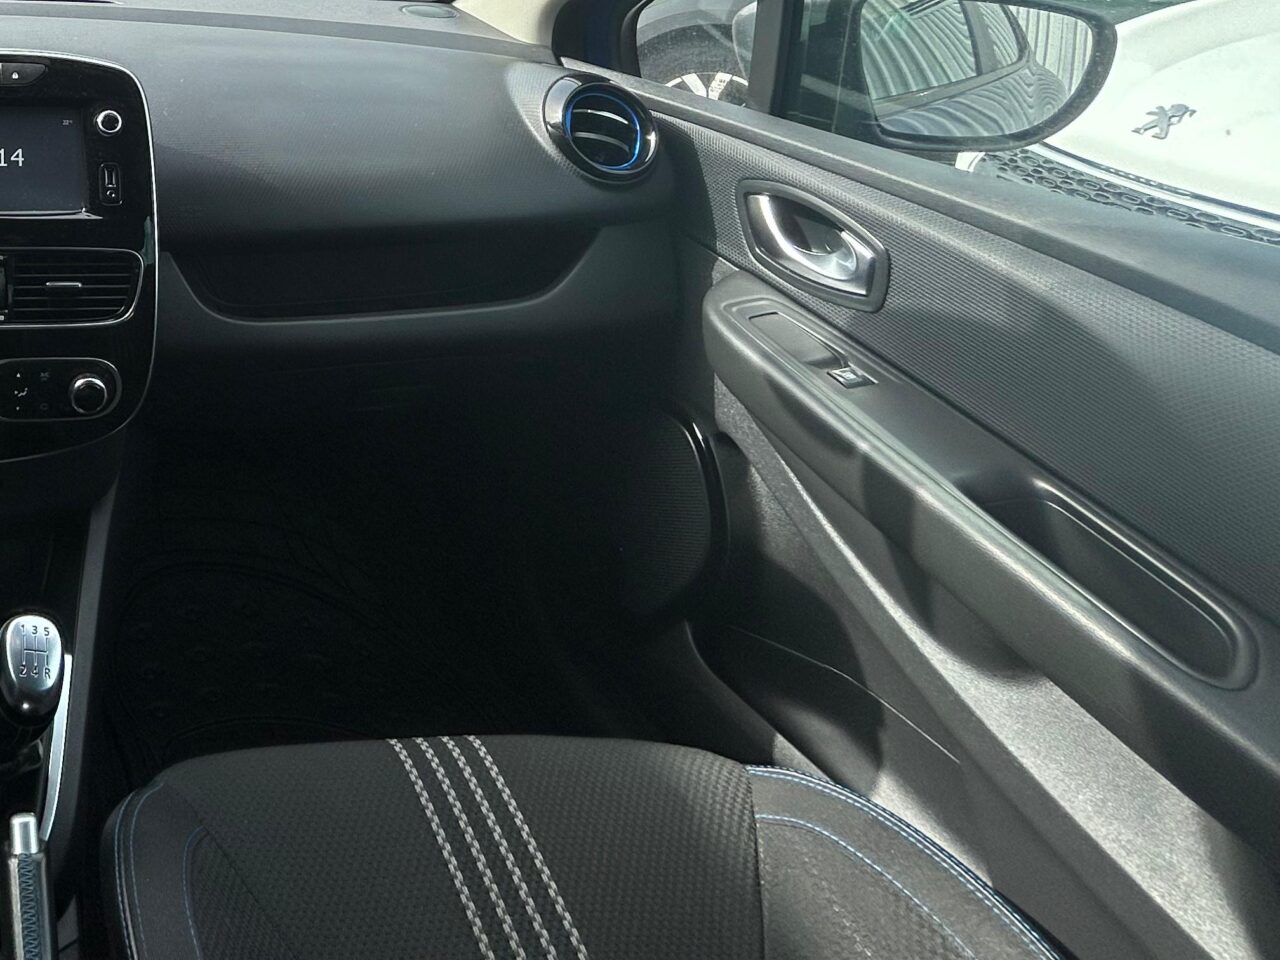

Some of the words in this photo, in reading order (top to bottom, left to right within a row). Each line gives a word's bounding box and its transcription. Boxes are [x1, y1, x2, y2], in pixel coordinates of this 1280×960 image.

[20, 624, 26, 633] 1
[31, 625, 38, 635] 3
[43, 626, 50, 636] 5
[19, 665, 27, 677] 2
[30, 665, 39, 678] 4
[43, 667, 51, 679] R
